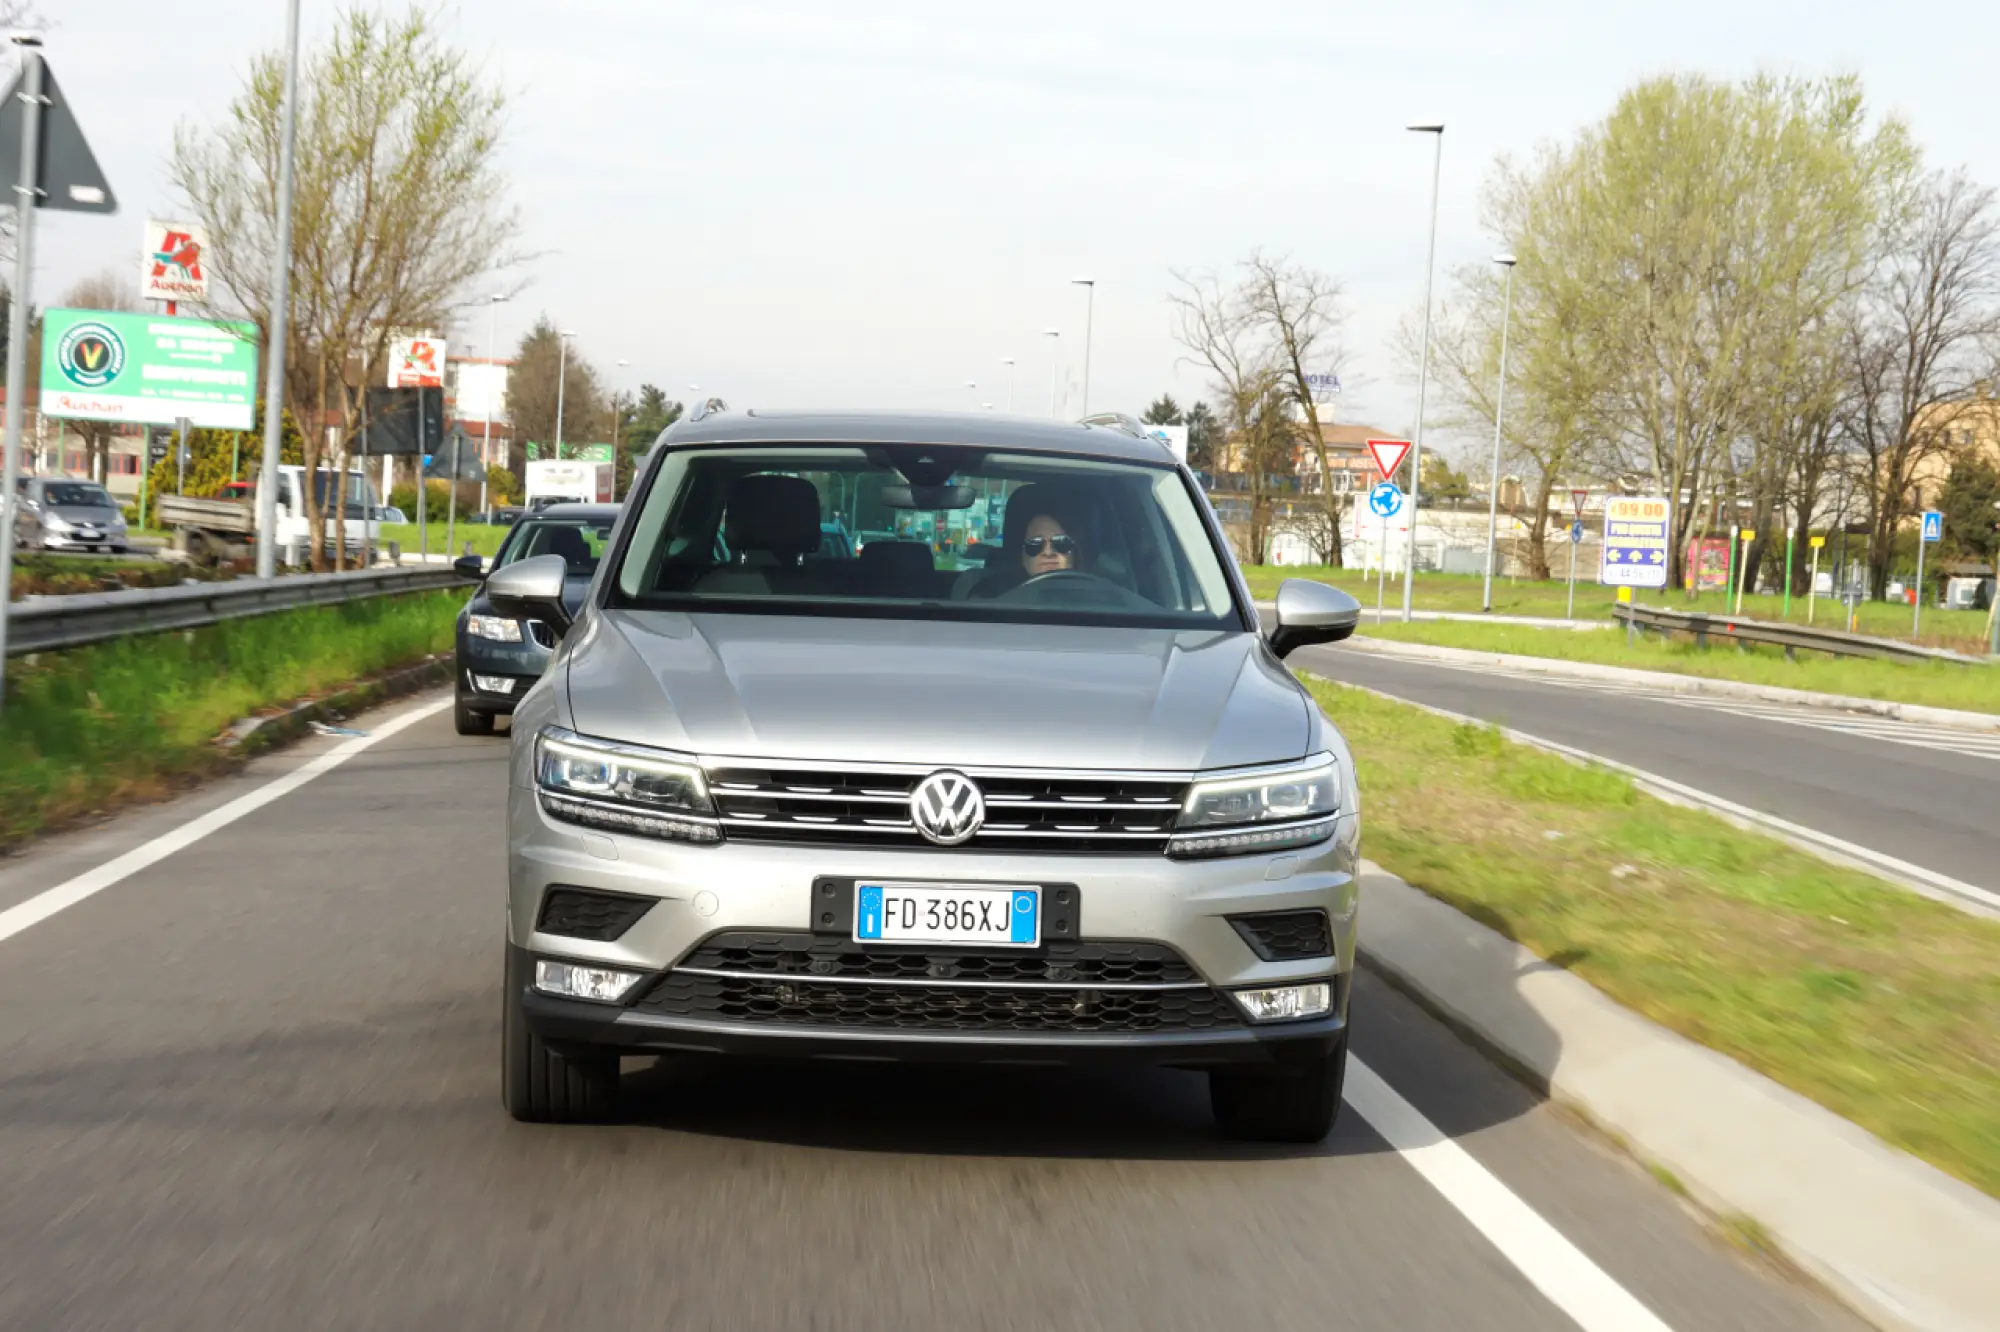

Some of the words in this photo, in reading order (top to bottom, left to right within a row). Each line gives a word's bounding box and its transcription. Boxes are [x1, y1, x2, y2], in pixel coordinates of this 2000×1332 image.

[150, 279, 204, 296] Auchan
[885, 898, 917, 930] FD
[926, 899, 1010, 932] 386XJ
